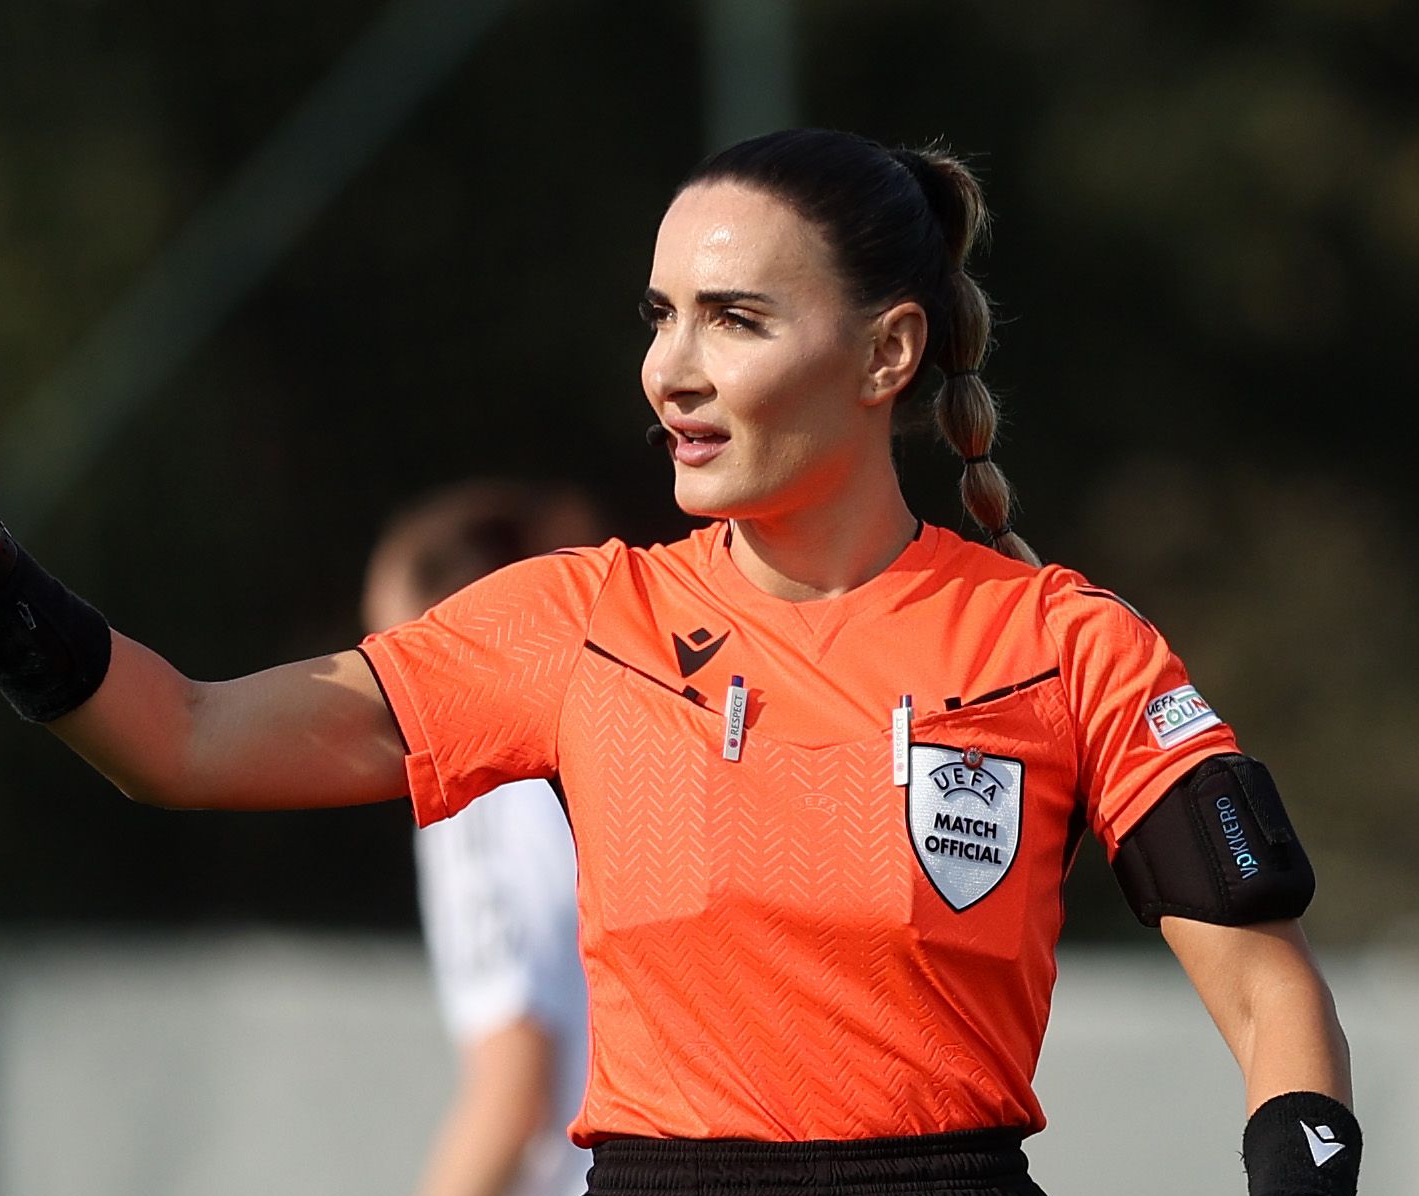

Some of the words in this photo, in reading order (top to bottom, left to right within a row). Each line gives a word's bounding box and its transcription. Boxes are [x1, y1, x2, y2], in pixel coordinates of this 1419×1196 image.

[730, 695, 743, 736] RESPECT
[1147, 695, 1176, 716] UEFA
[933, 767, 997, 801] UEFA
[934, 812, 998, 839] MATCH
[1216, 796, 1259, 880] VOKKERO
[924, 835, 1002, 865] OFFICIAL
